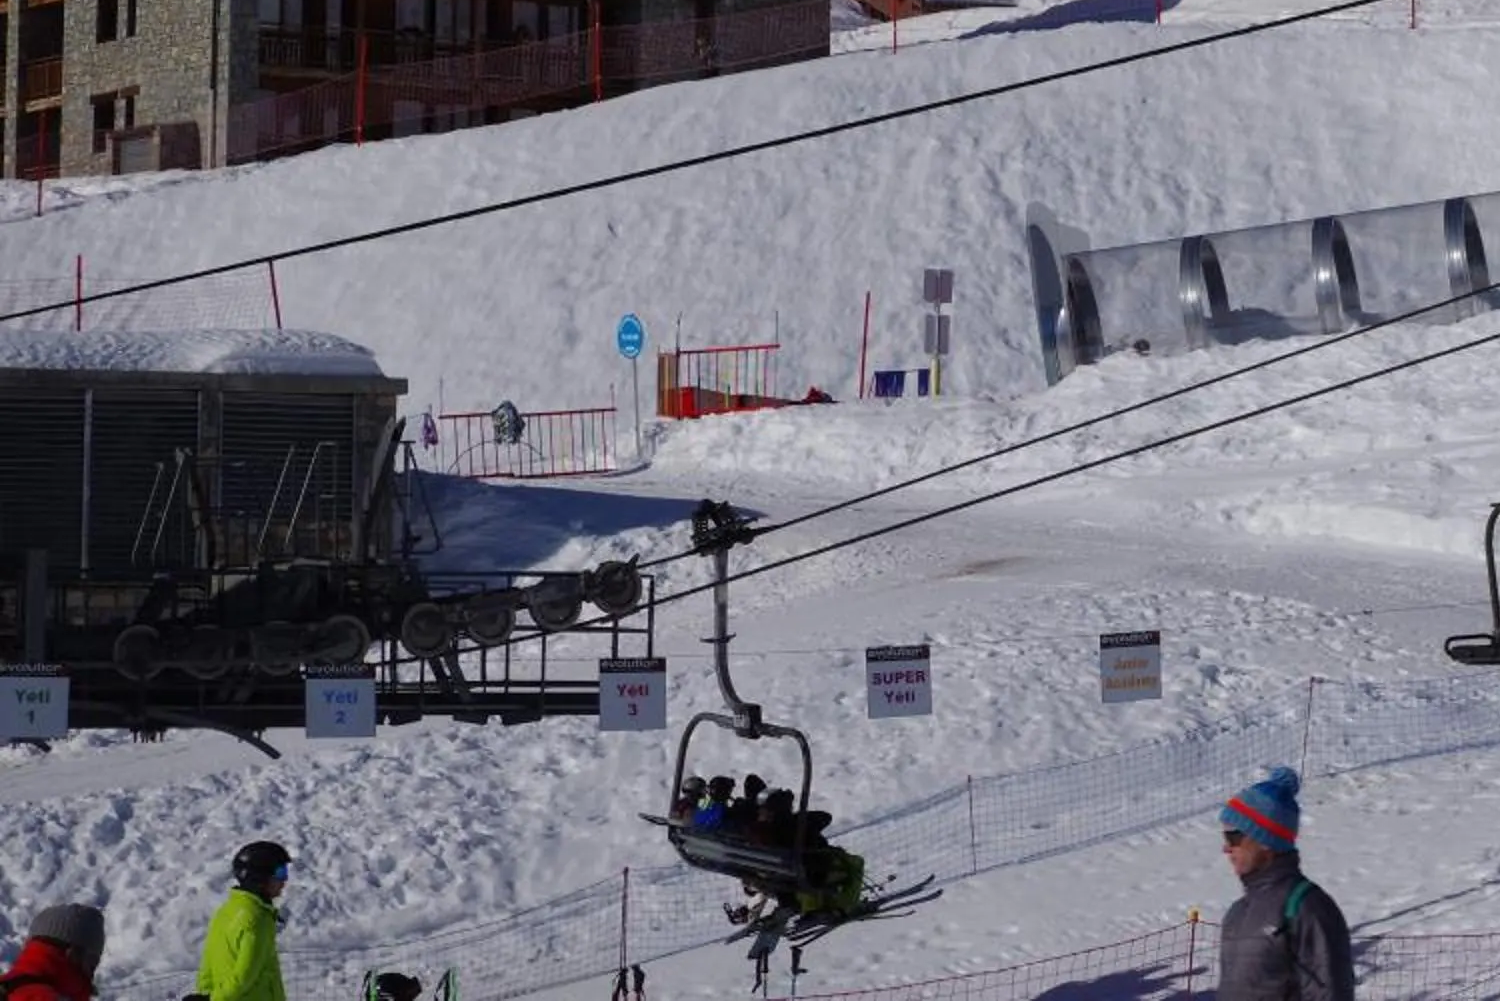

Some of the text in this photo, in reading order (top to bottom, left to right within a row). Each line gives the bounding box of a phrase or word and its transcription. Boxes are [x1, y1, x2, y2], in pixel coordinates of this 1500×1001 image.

[872, 670, 926, 686] SUPER
[627, 703, 637, 716] 3
[26, 710, 35, 725] 1
[335, 710, 346, 725] 2
